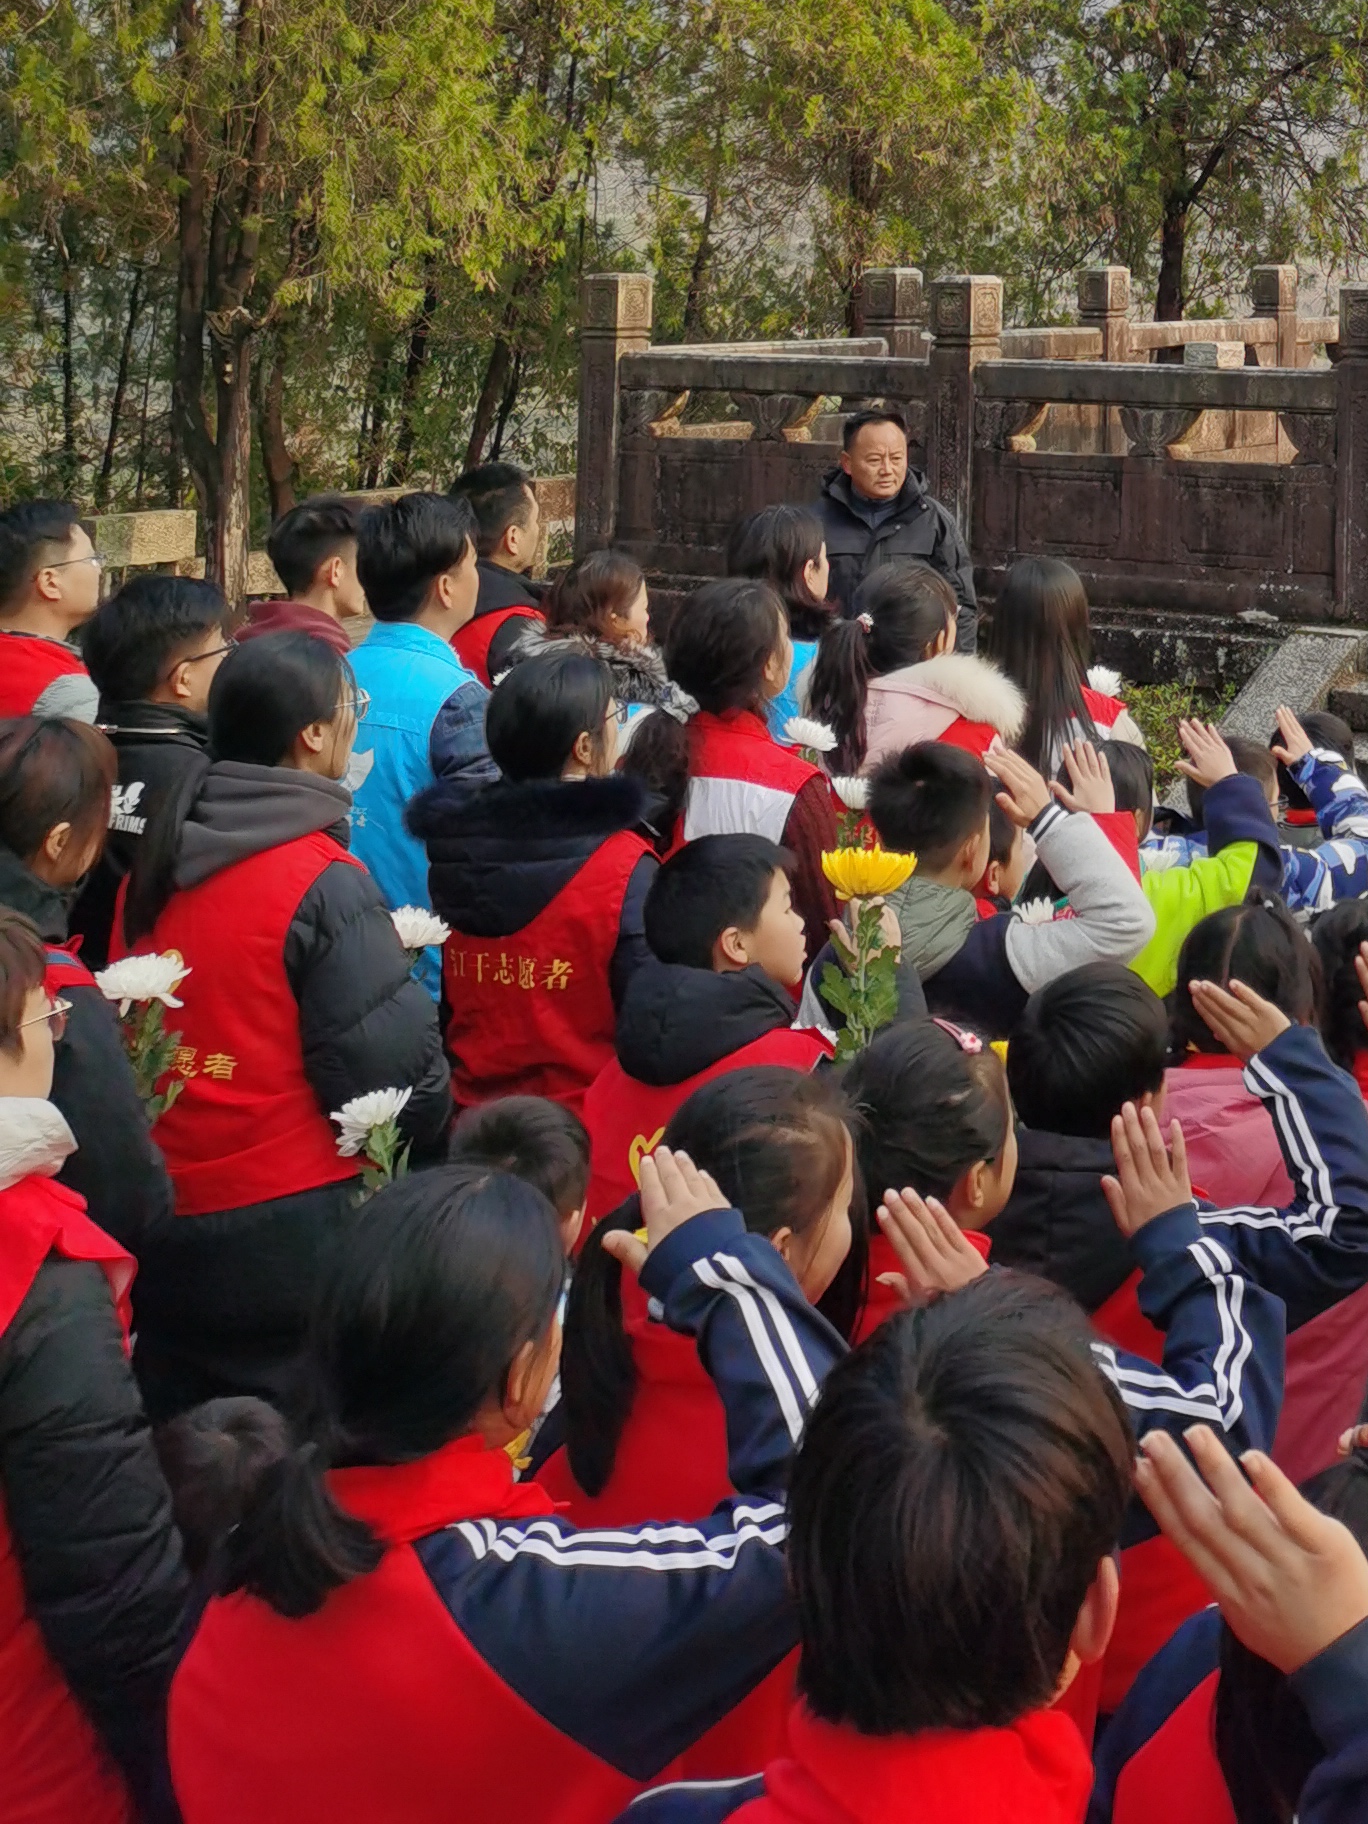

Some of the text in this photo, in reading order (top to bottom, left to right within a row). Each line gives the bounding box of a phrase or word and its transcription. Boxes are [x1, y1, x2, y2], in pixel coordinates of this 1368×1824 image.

[450, 948, 574, 990] 江干志愿者
